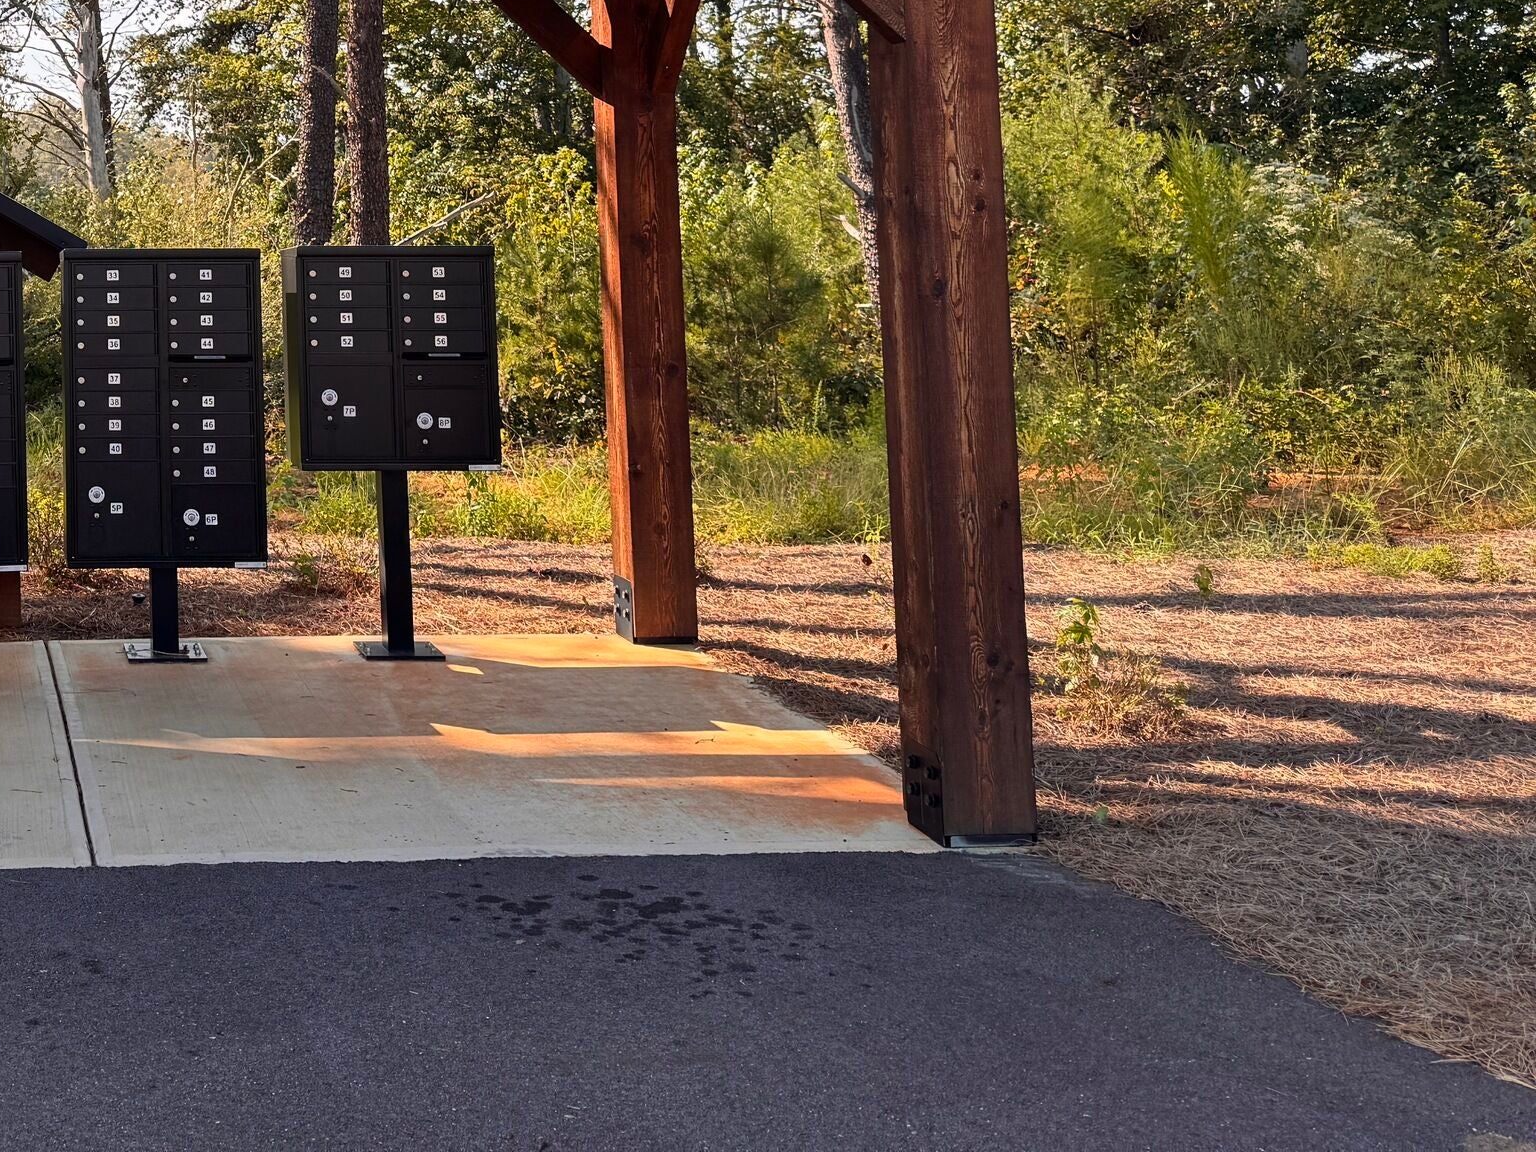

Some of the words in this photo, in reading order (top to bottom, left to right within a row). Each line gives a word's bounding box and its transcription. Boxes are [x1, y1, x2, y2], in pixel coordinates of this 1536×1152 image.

[108, 271, 118, 279] 33
[340, 268, 350, 277] 49
[433, 268, 444, 276] 53
[341, 291, 351, 299] 50
[201, 316, 212, 325] 43
[109, 340, 119, 348] 36
[436, 337, 446, 345] 56
[110, 398, 120, 406] 38
[203, 398, 214, 406] 45
[345, 407, 355, 415] 7P
[110, 421, 120, 429] 39
[203, 420, 214, 429] 46
[439, 419, 450, 427] 8P
[110, 444, 121, 453] 40
[204, 444, 214, 452] 47
[205, 468, 215, 476] 48
[111, 504, 122, 512] 5P
[206, 515, 217, 524] 6P
